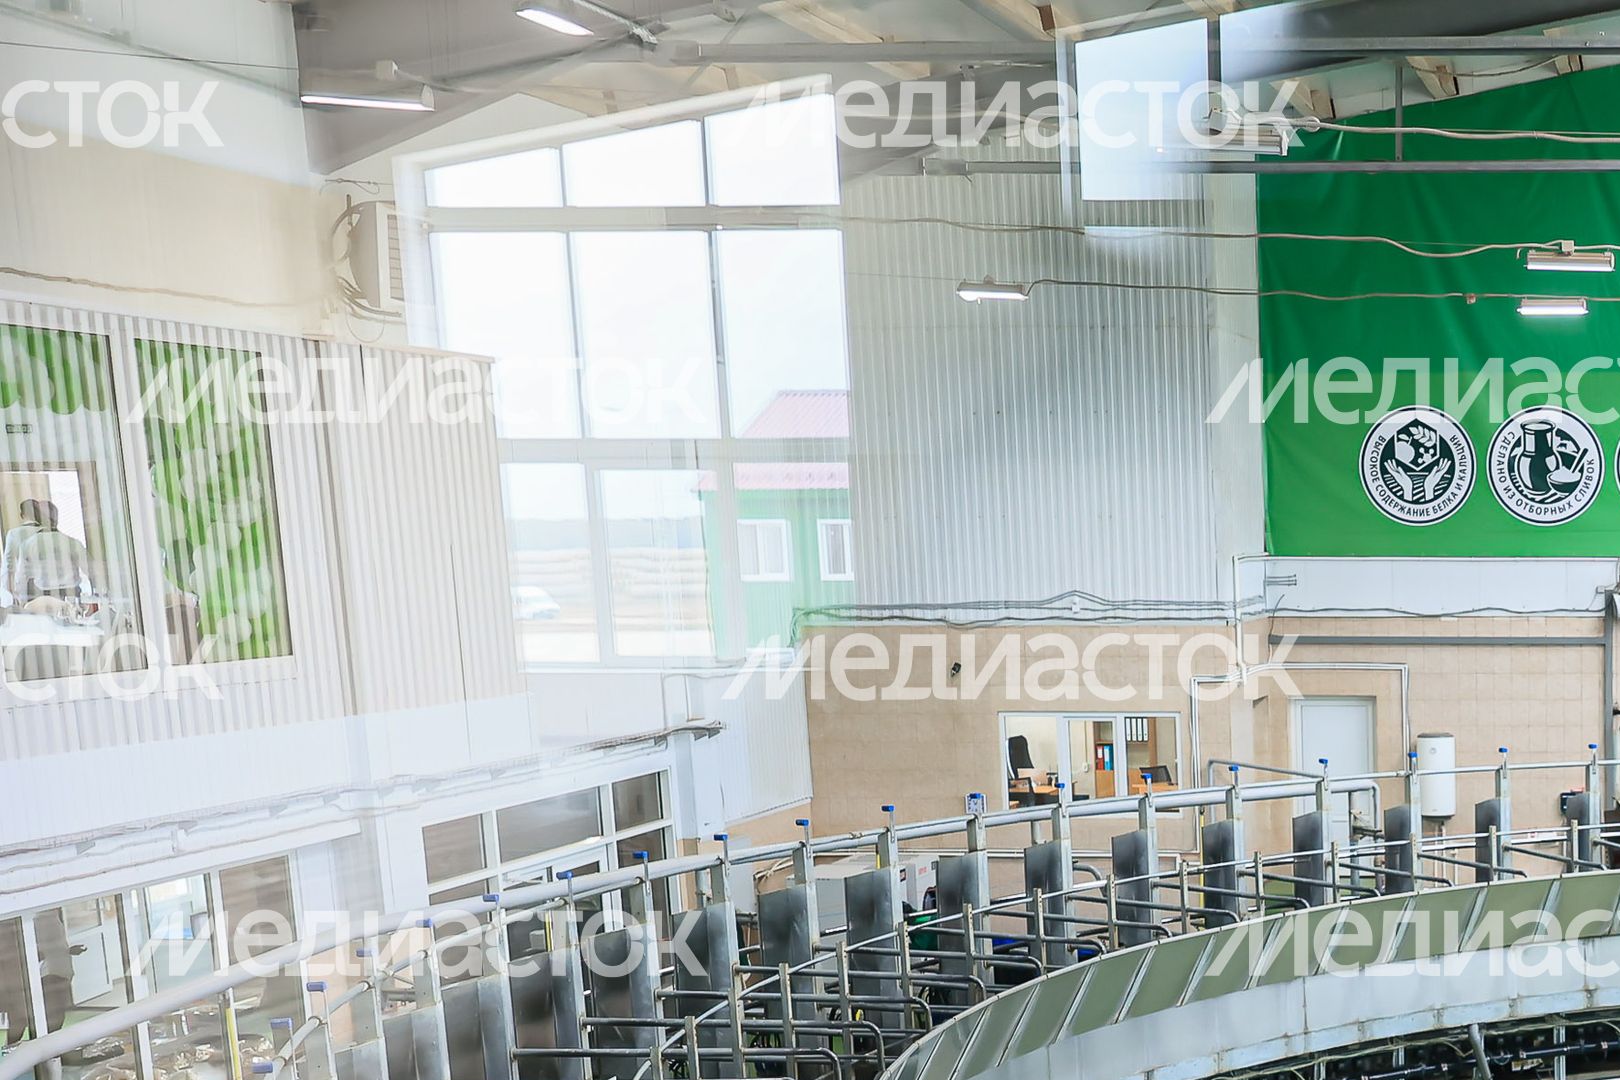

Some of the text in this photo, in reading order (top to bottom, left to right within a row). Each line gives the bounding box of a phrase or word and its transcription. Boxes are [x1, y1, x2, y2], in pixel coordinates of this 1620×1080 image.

[1369, 434, 1468, 517] ВЫСОКОЕ СОДЕРЖАНИЕ БЕЛКА И КАЛЬЦИЯ
[1496, 431, 1595, 516] СДЕЛАНО ИЗ ОТБОРНЫХ СЛИВОК
